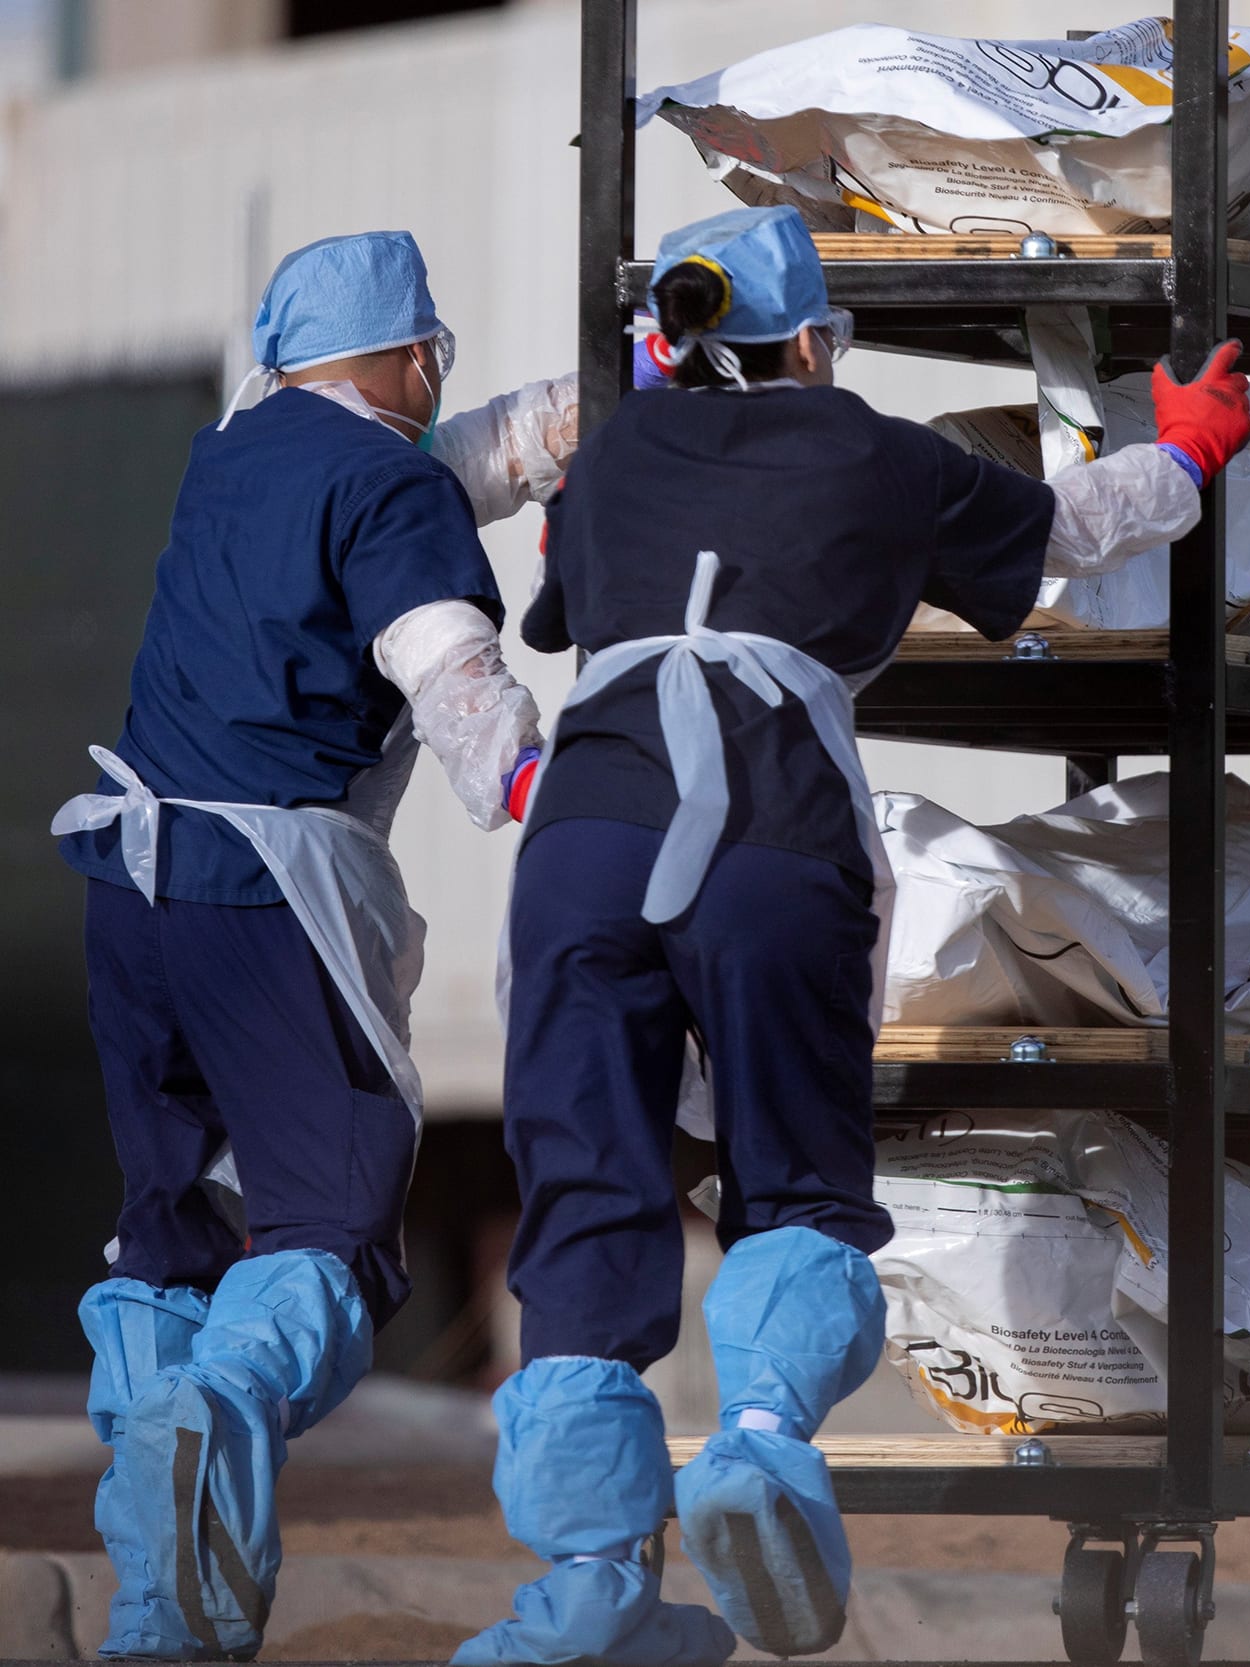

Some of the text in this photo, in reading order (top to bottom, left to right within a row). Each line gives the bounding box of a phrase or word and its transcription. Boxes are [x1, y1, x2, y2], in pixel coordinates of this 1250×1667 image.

[877, 64, 954, 83] Containment
[972, 162, 1006, 173] Level
[991, 1325, 1051, 1342] Biosafety
[1054, 1330, 1089, 1341] Level
[1090, 1330, 1097, 1340] 4
[1013, 1344, 1026, 1353] De
[1028, 1345, 1041, 1354] La
[1107, 1347, 1128, 1356] Nivel
[1021, 1357, 1066, 1370] Biosafety
[1067, 1360, 1087, 1370] Stuf
[1098, 1361, 1144, 1372] Verpackung
[1010, 1362, 1061, 1381] Biosécurité
[1062, 1373, 1094, 1383] Niveau
[1105, 1375, 1158, 1385] Confinement
